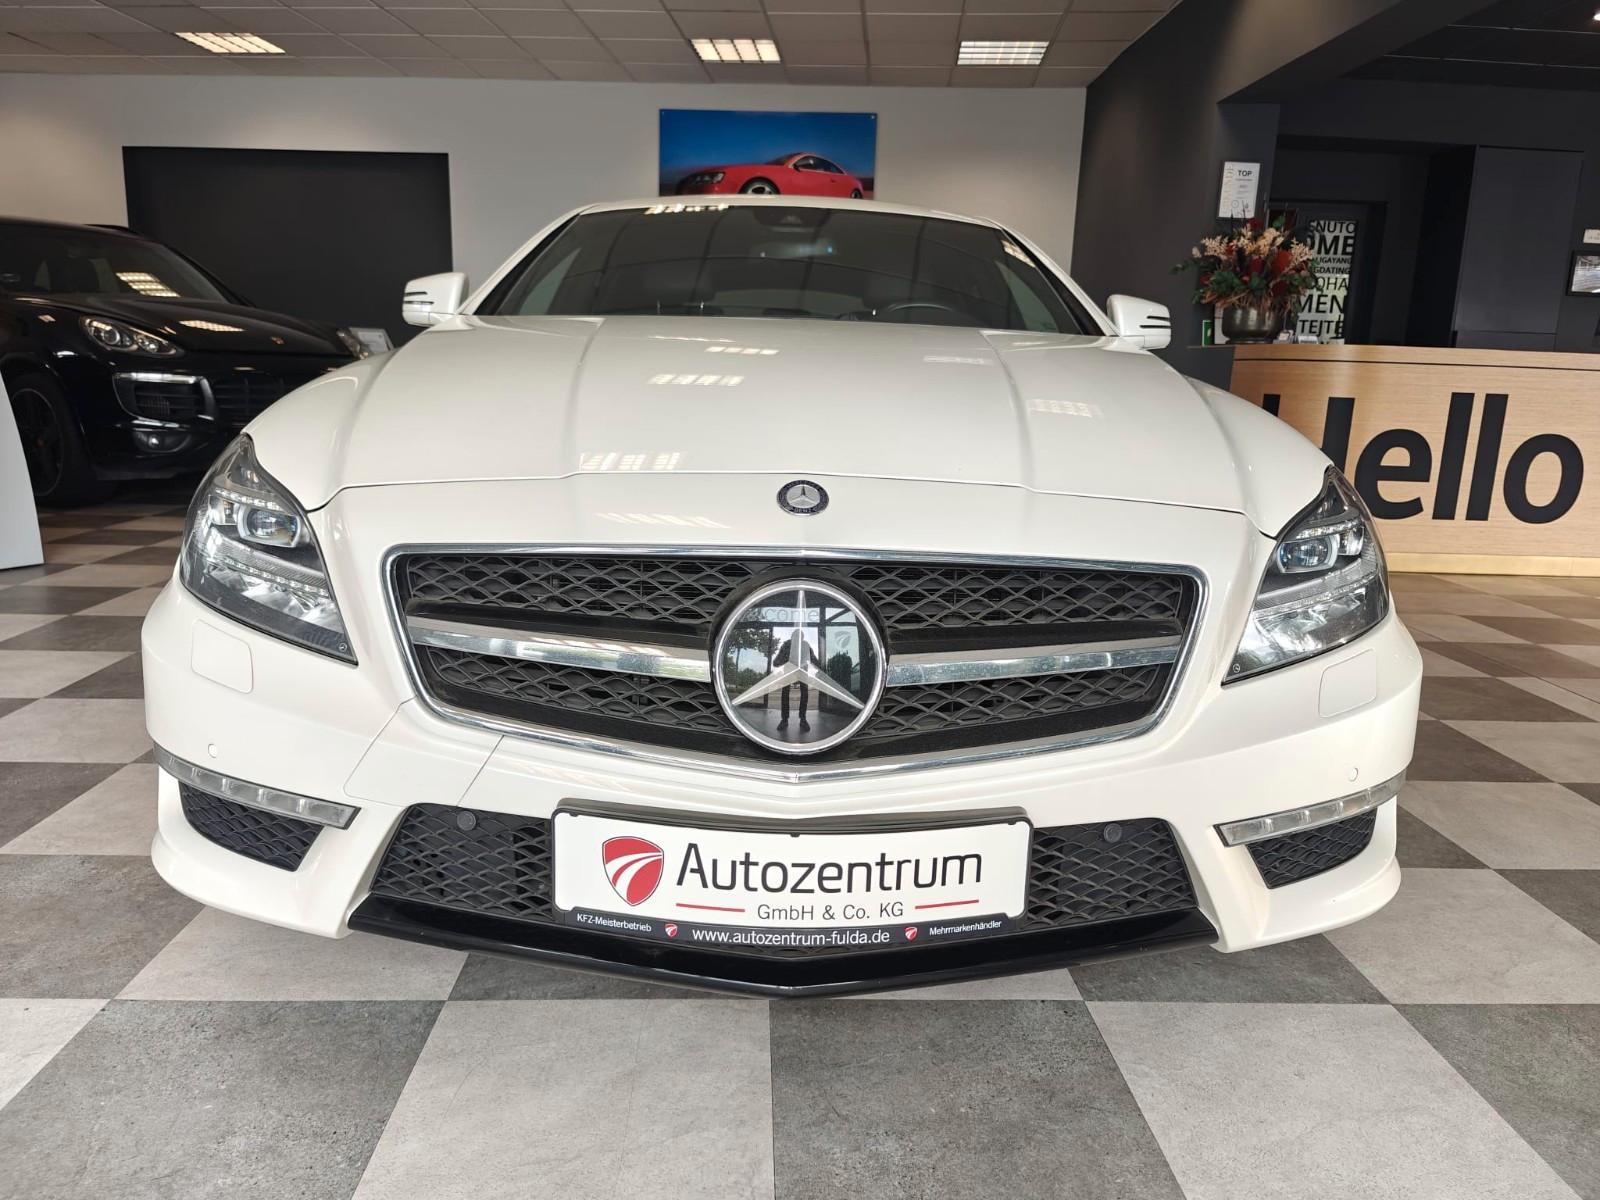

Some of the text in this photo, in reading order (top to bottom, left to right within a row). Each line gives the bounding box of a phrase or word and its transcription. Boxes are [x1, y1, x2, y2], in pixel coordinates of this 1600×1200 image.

[676, 843, 983, 894] Autozentrum
[757, 902, 903, 920] GmbH & Co. KG
[577, 913, 652, 932] KFZ-Meisterbetrieb
[929, 920, 1002, 936] Mehrmarkenhändler
[692, 929, 890, 946] www.autozentrum-fulda.de
